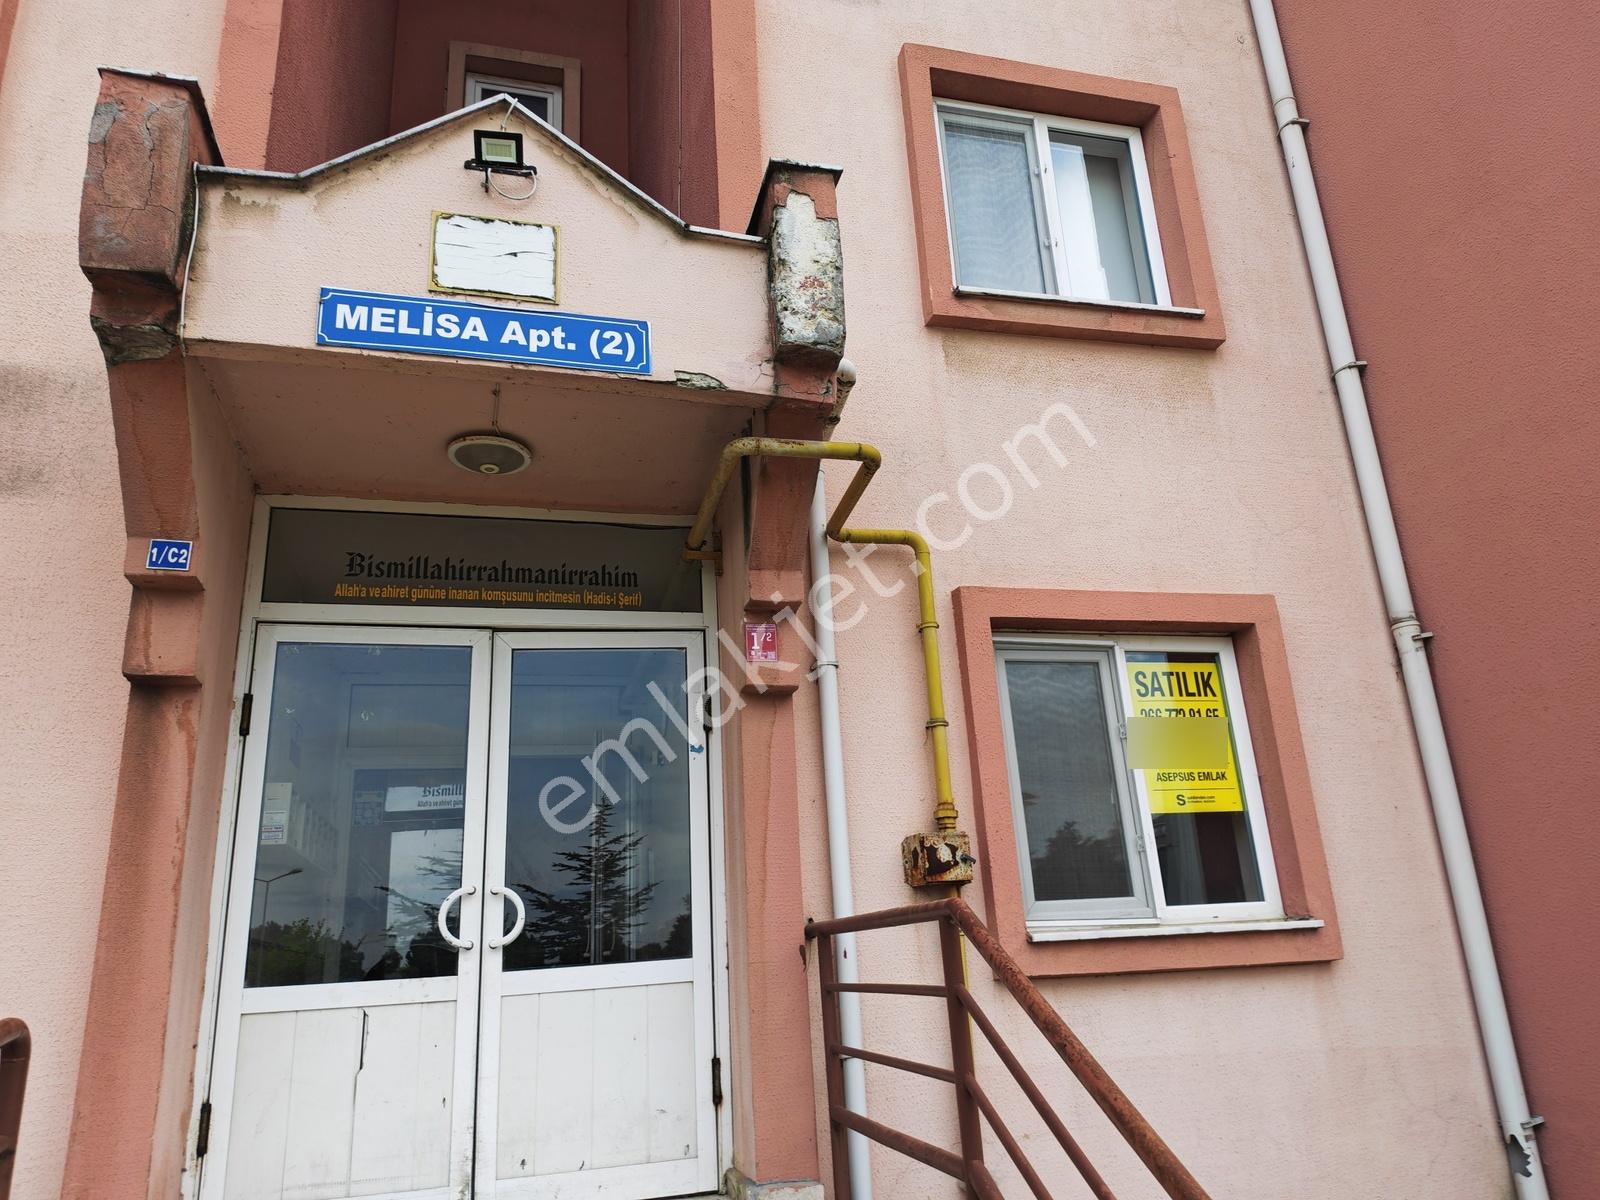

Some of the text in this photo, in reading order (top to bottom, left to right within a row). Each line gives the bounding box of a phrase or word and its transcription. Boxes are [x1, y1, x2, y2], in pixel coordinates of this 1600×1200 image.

[334, 302, 636, 362] MELİSA Apt. (2)
[151, 546, 188, 564] 1/C2
[345, 551, 640, 588] Bismillahirrahmanirrahim
[334, 583, 367, 597] Allah'a
[381, 585, 410, 598] ahiret
[411, 585, 447, 601] gününe
[448, 587, 479, 600] inanan
[481, 588, 533, 605] komşusunu
[536, 589, 581, 604] incitmesin
[618, 591, 642, 608] Şerif)
[1135, 670, 1217, 698] SATILIK
[1156, 771, 1228, 782] ASEPSUS EMLAK
